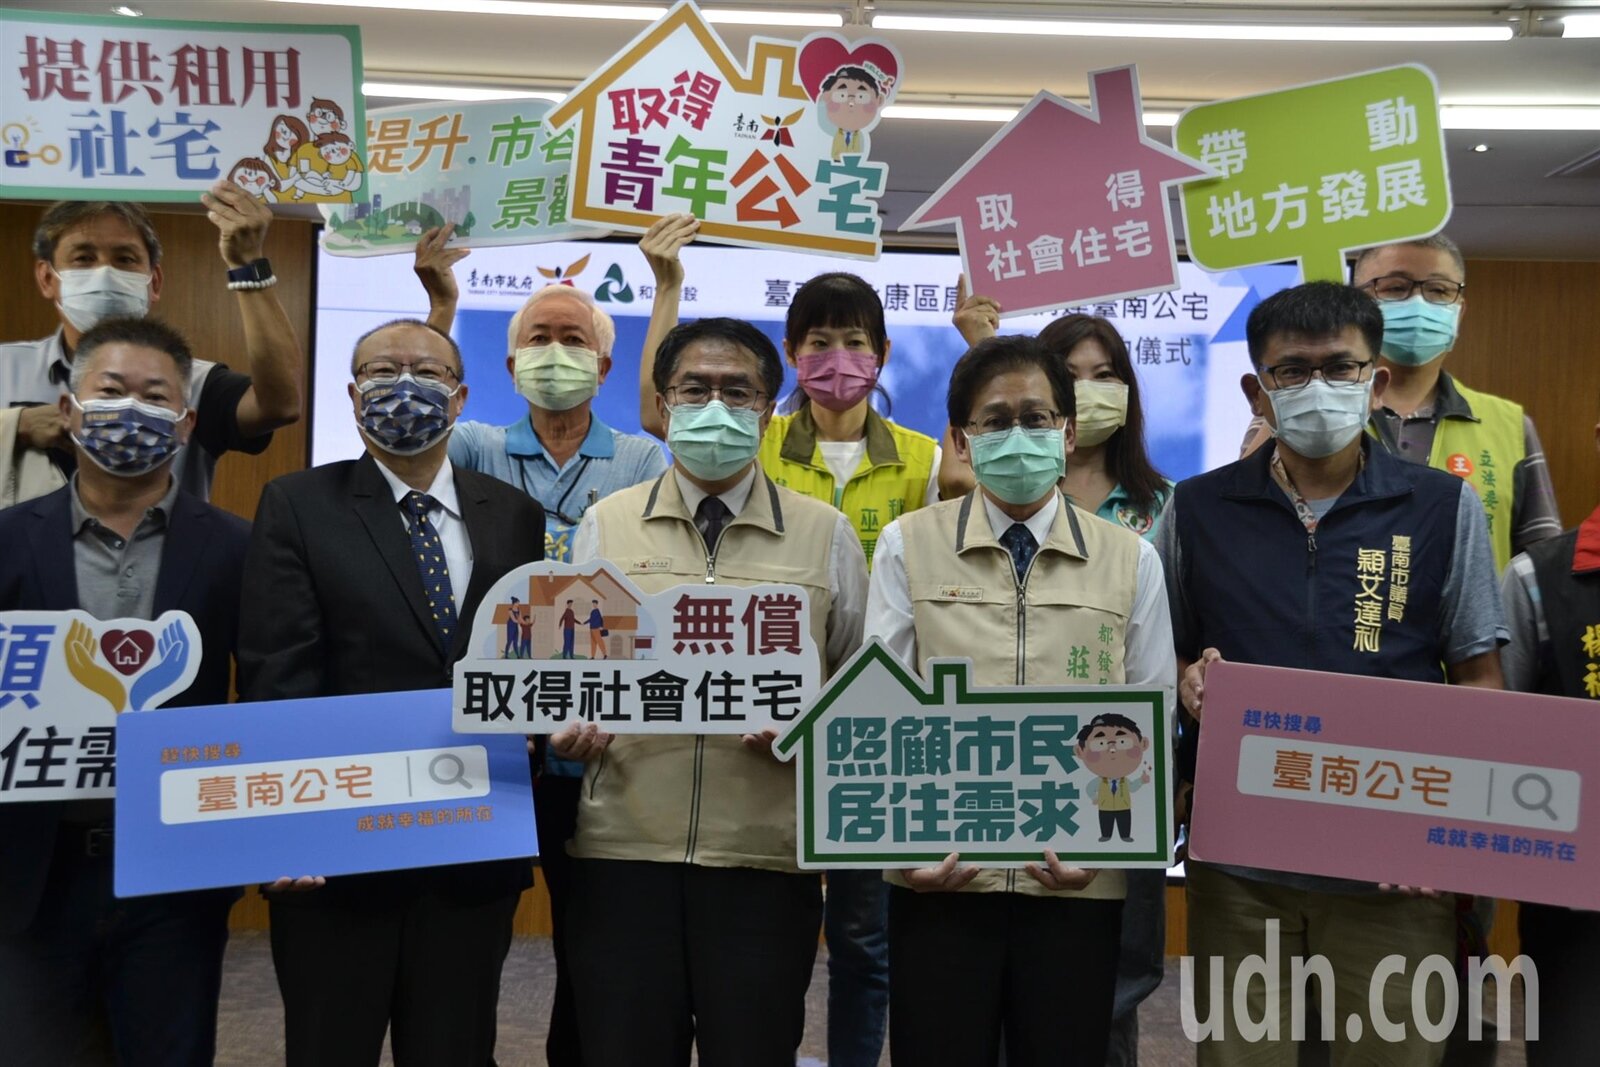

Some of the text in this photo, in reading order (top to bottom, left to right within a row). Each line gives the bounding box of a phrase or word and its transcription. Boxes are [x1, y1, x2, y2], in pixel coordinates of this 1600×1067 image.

[19, 35, 301, 109] 提供租用
[608, 70, 721, 135] 取得
[69, 110, 222, 180] 社宅
[366, 113, 469, 173] 提升
[1197, 97, 1417, 179] 帶 動
[600, 134, 883, 236] 青年公宅
[976, 170, 1146, 232] 取 得
[1206, 159, 1428, 240] 地方發展
[986, 220, 1152, 282] 社會住宅
[673, 593, 803, 656] 無償
[1066, 645, 1090, 678] 莊
[462, 669, 803, 722] 取得社會住宅
[1243, 708, 1322, 734] 趕快搜尋
[826, 714, 1080, 777] 照顧市民
[197, 764, 373, 813] 臺南公宅
[1272, 749, 1452, 808] 臺南公宅
[356, 804, 494, 832] 成就幸福的所在
[825, 781, 1080, 843] 居住需求
[1427, 826, 1576, 862] 成就幸福的所在
